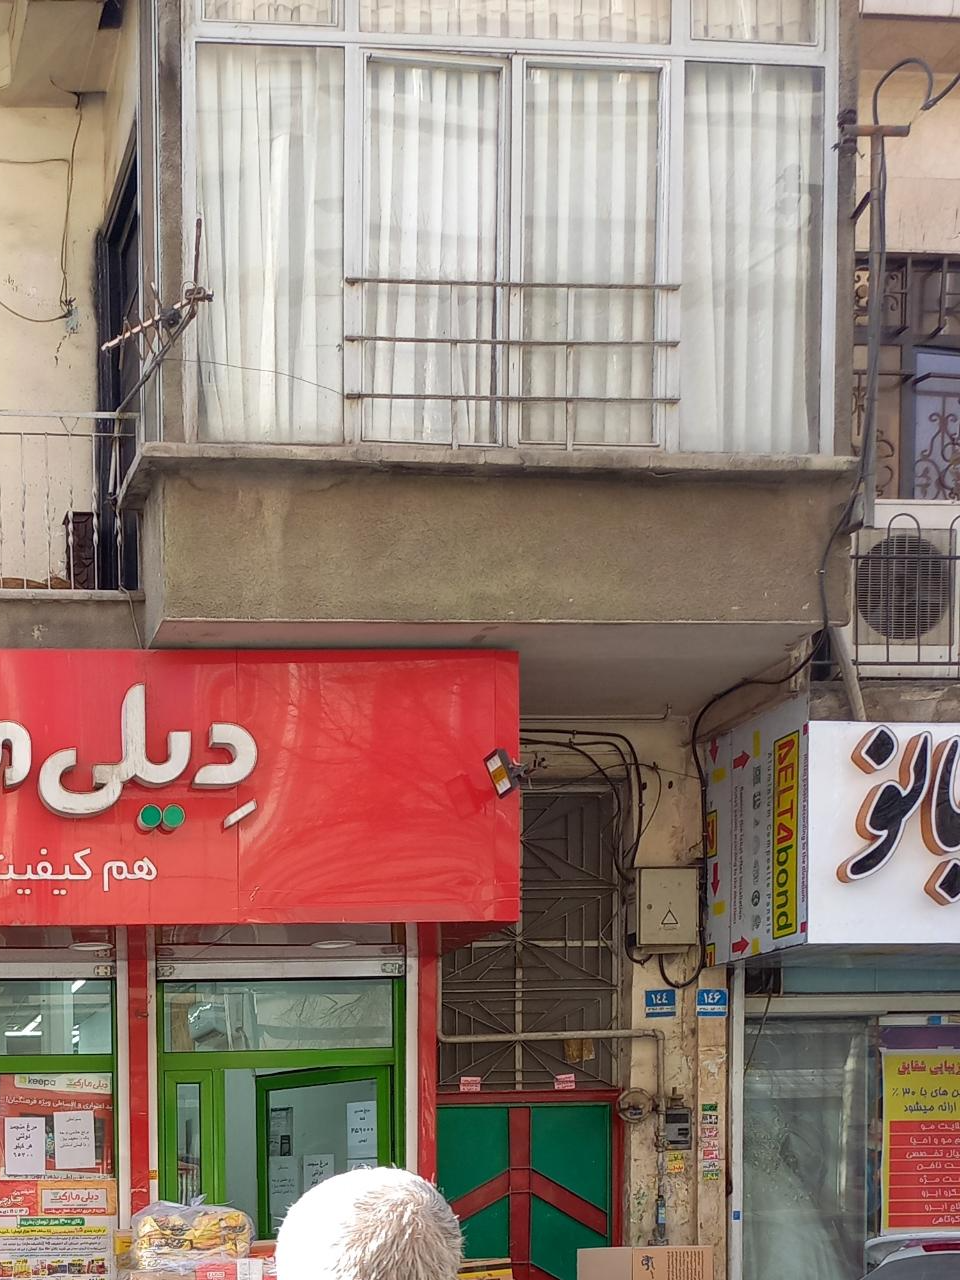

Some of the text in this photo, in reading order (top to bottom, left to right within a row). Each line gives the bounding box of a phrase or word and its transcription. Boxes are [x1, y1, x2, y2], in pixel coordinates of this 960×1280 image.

[103, 856, 158, 891] هم
[27, 1075, 56, 1087] keepa
[50, 1190, 80, 1203] مارکت
[80, 1192, 100, 1203] دیلی
